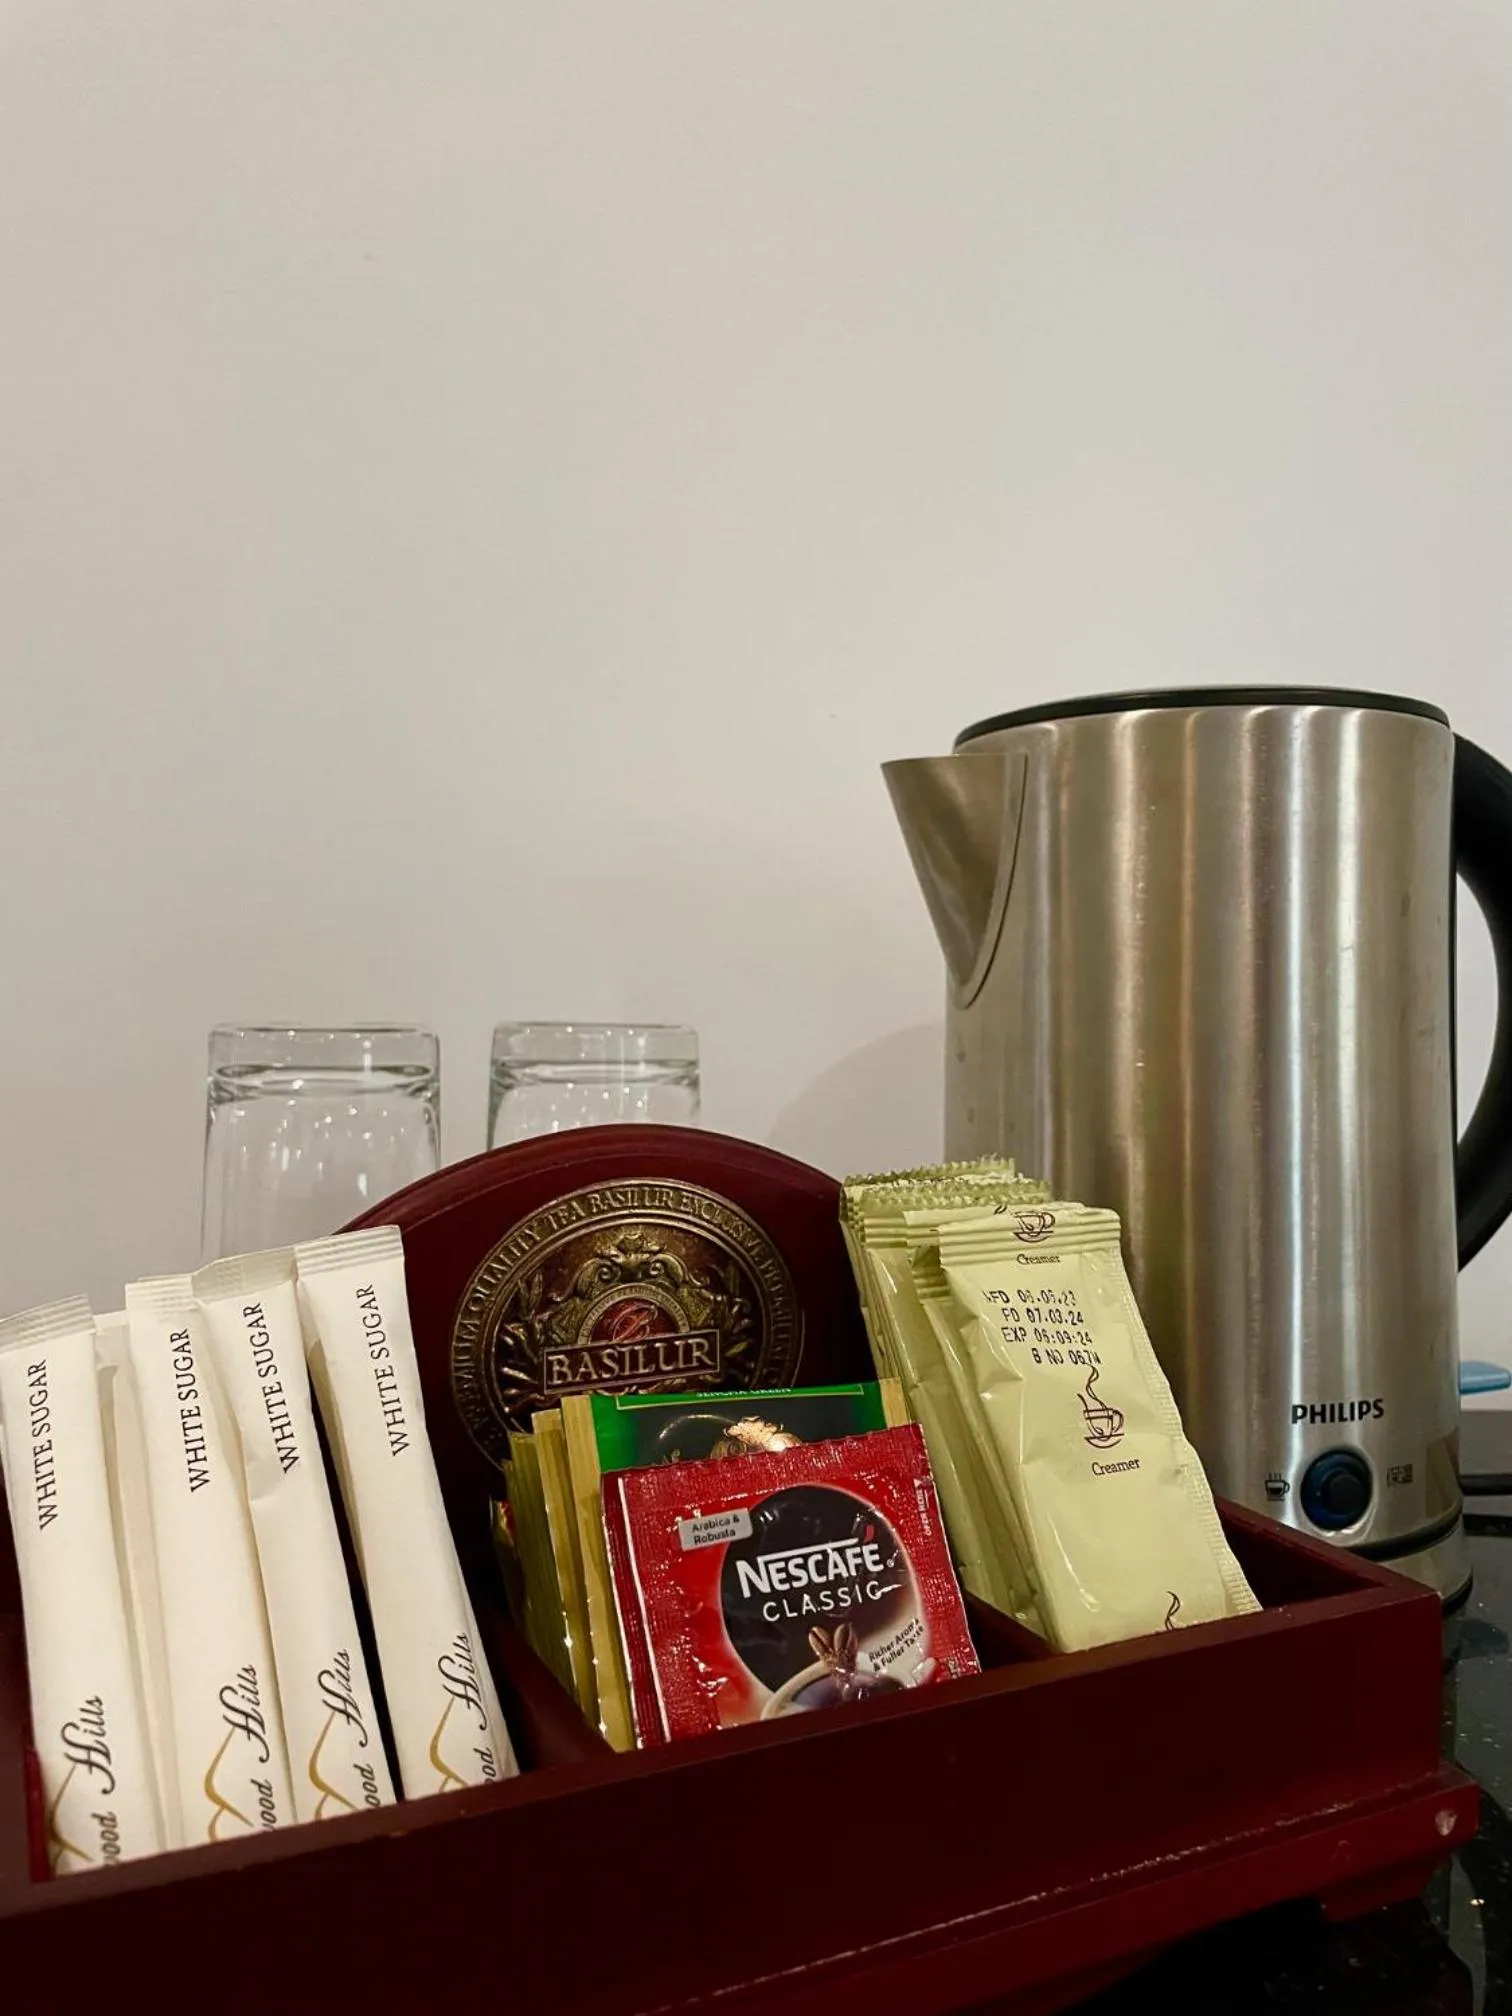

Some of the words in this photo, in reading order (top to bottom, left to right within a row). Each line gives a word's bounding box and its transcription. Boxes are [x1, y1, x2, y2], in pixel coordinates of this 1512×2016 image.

[546, 1199, 587, 1231] TEA
[587, 1186, 675, 1214] BASILUR
[1016, 1253, 1062, 1265] Creamer
[242, 1302, 278, 1379] SUGAR
[355, 1283, 390, 1361] SUGAR
[1001, 1326, 1027, 1343] EXP
[169, 1328, 199, 1402] SUGAR
[547, 1336, 716, 1385] BASILUR
[27, 1359, 51, 1438] SUGAR
[262, 1380, 300, 1474] WHITE
[374, 1364, 411, 1458] WHITE
[1291, 1398, 1385, 1425] PHILIPS
[33, 1439, 60, 1531] WHITE
[181, 1405, 211, 1493] WHITE
[1091, 1459, 1140, 1476] Creamer
[692, 1517, 731, 1533] Arabica
[693, 1528, 736, 1545] Robusta
[762, 1581, 883, 1622] CLASSIC
[437, 1632, 488, 1731] Hills
[869, 1642, 895, 1663] Richer
[218, 1663, 271, 1763] Hills
[317, 1648, 369, 1748] Hills
[61, 1695, 116, 1795] Hills
